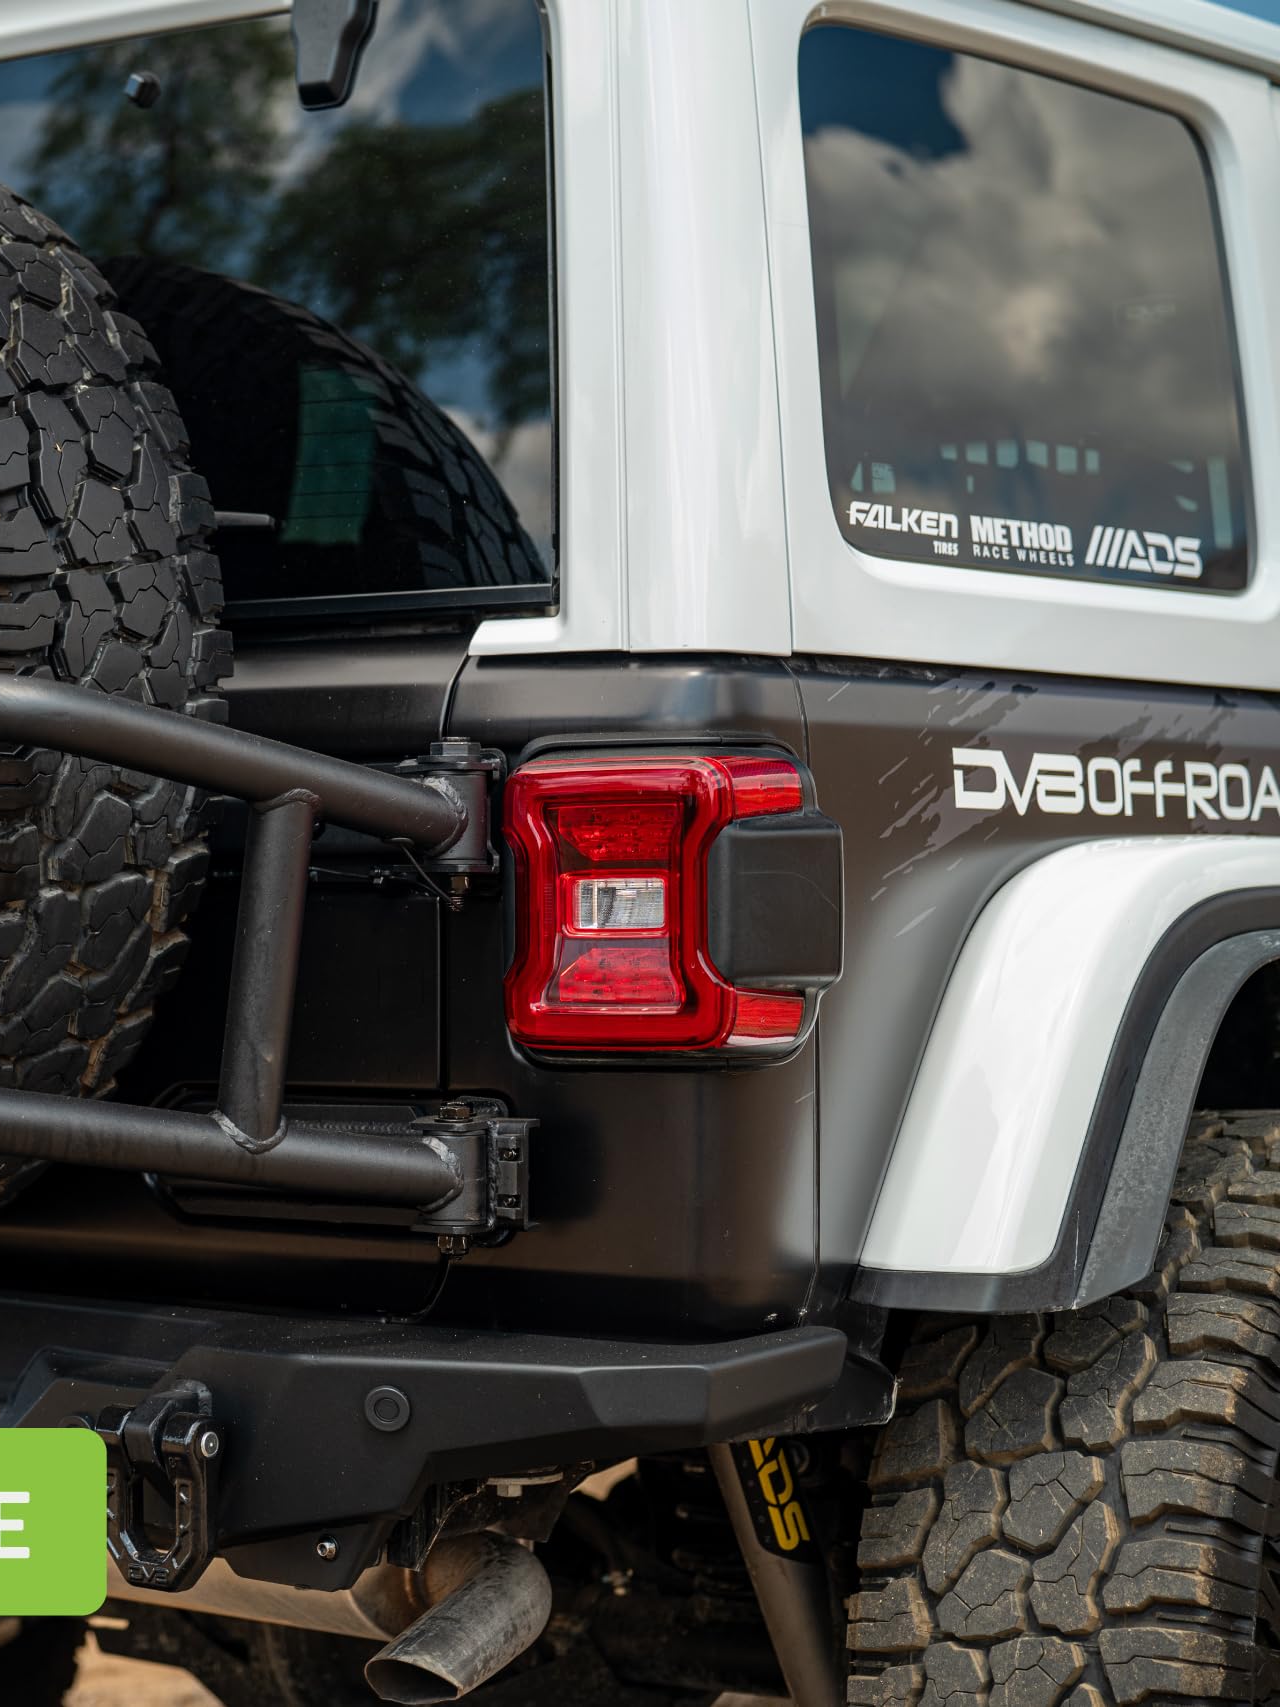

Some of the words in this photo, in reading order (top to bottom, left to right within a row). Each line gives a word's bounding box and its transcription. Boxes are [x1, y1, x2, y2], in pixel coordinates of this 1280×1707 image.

[847, 501, 959, 539] FALKEN
[969, 515, 1073, 553] METHOD
[932, 539, 960, 557] TIRES
[972, 544, 1010, 561] RACE
[1016, 547, 1075, 568] WHEELS
